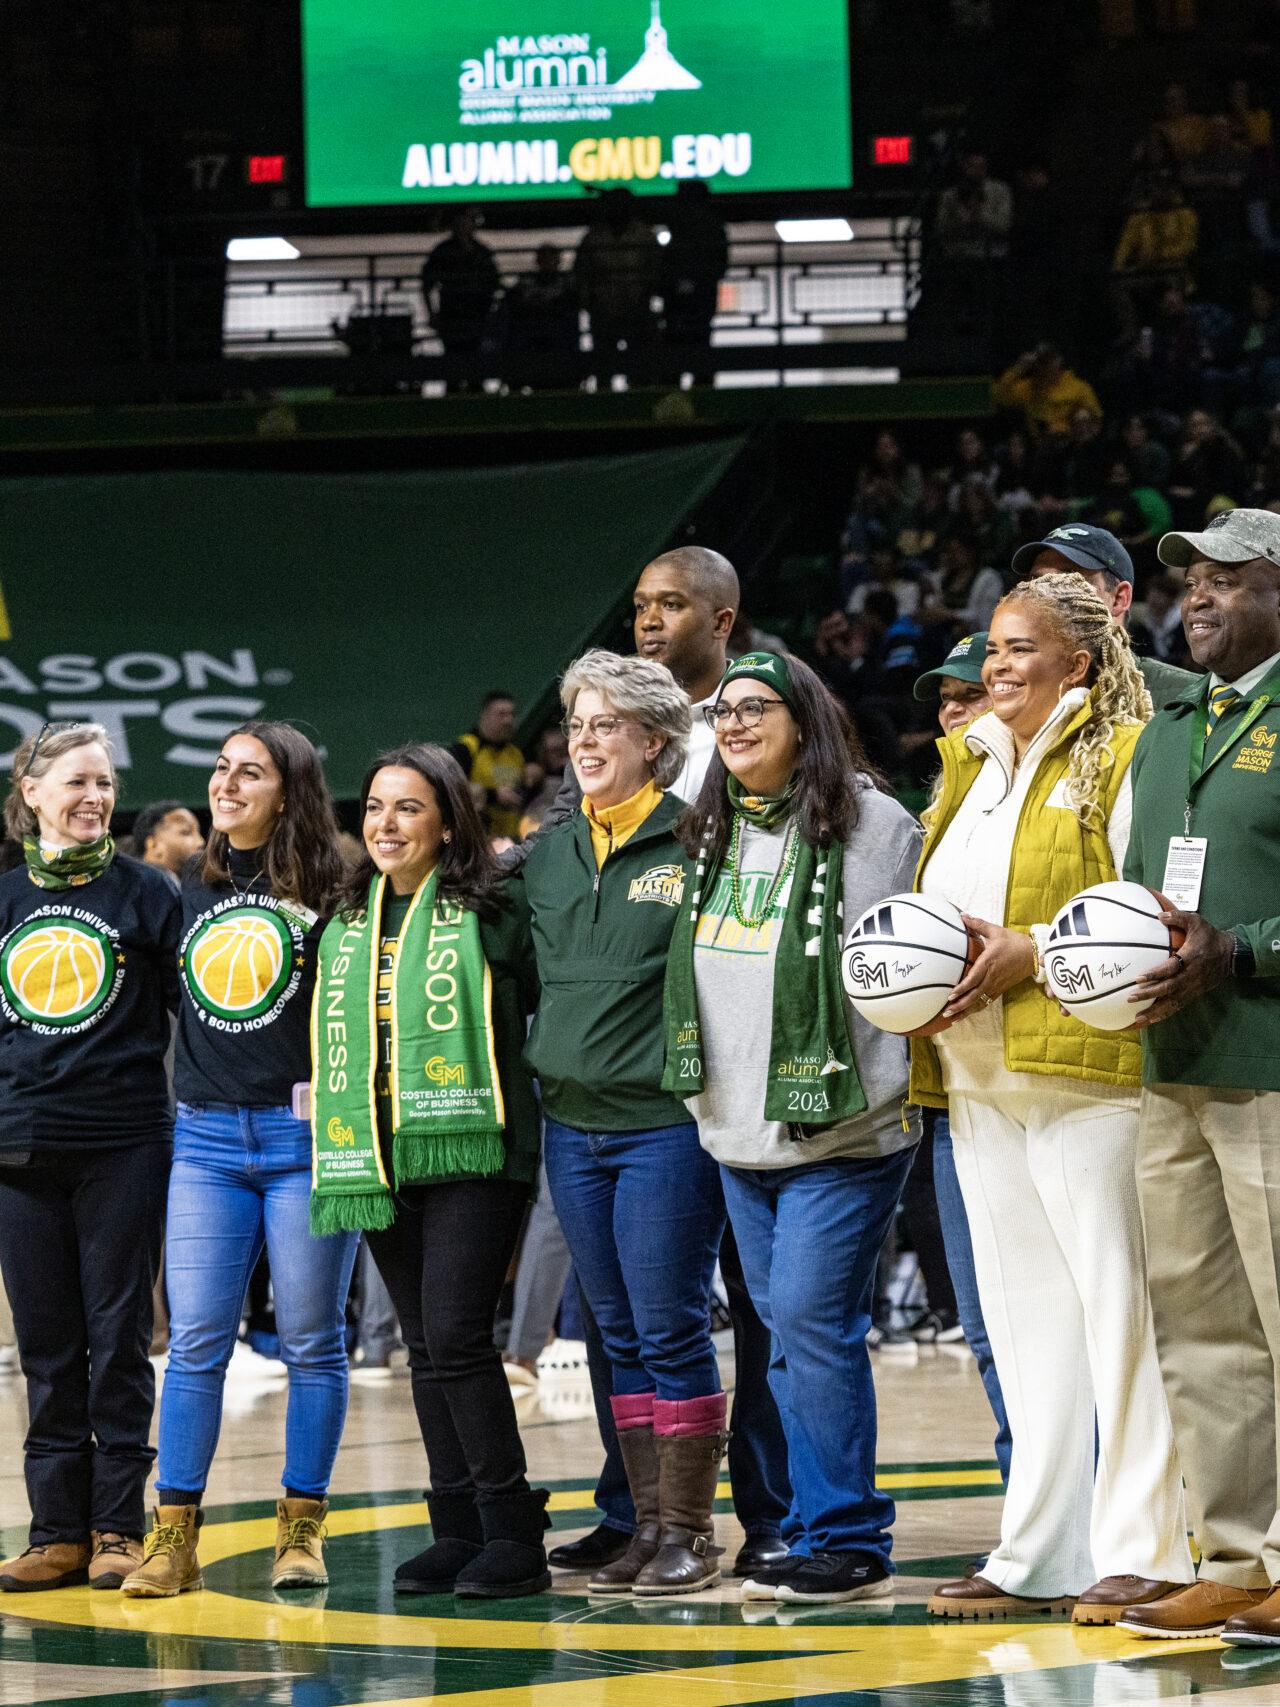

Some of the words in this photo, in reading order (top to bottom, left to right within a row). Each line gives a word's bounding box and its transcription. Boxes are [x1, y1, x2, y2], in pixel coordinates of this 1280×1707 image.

[497, 33, 590, 56] MASON
[459, 48, 607, 92] alumni
[403, 133, 751, 187] ALUMNI.GMU.EDU
[1240, 747, 1275, 759] GEORGE
[1235, 754, 1272, 767] MASON
[1231, 763, 1267, 774] UNIVERSITY
[628, 880, 684, 903] MASON
[62, 968, 125, 1034] HOMECOMING
[198, 1009, 207, 1022] &
[208, 1016, 242, 1033] BOLD
[243, 971, 302, 1032] HOMECOMING
[400, 1090, 447, 1100] COSTELLO
[449, 1088, 492, 1098] COLLEGE
[416, 1101, 429, 1109] OF
[431, 1098, 478, 1109] BUSINESS
[409, 1110, 431, 1118] George
[431, 1109, 452, 1117] Mason
[345, 1149, 374, 1159] COLLEGE
[332, 1159, 365, 1169] BUSINESS
